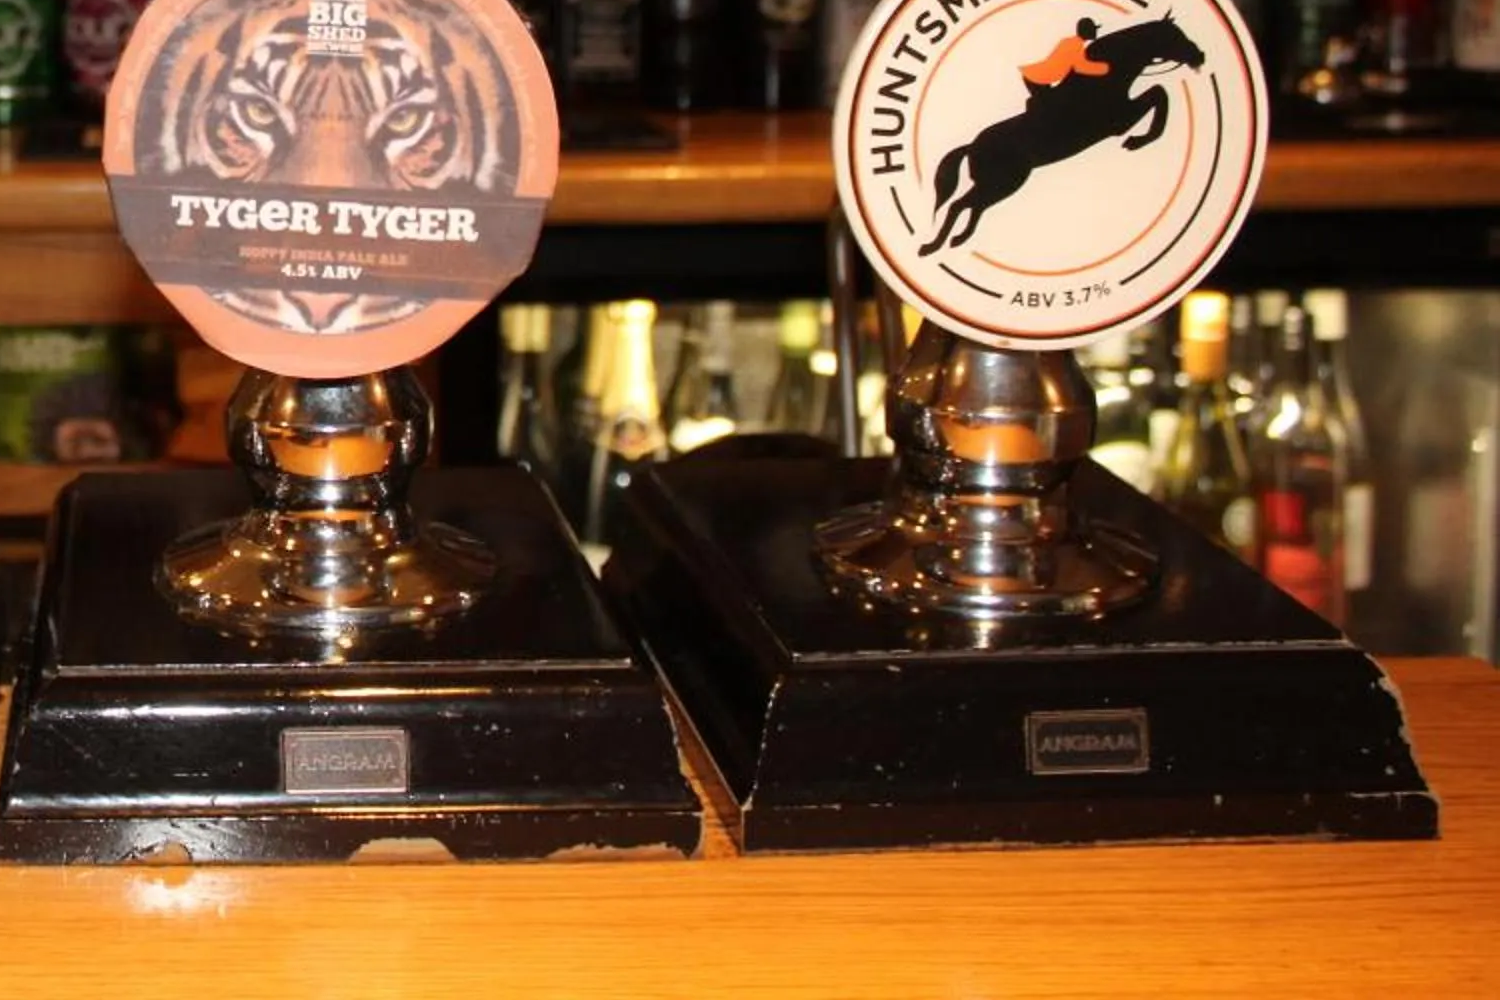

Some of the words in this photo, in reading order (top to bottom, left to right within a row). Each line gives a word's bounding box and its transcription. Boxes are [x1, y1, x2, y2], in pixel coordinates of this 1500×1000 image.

[308, 1, 367, 27] BIG
[307, 26, 367, 42] SHED
[328, 201, 480, 243] TYGER
[280, 262, 317, 278] 4.5%
[321, 265, 363, 281] ABV
[1010, 289, 1056, 309] ABV
[1064, 283, 1112, 307] 3.7%
